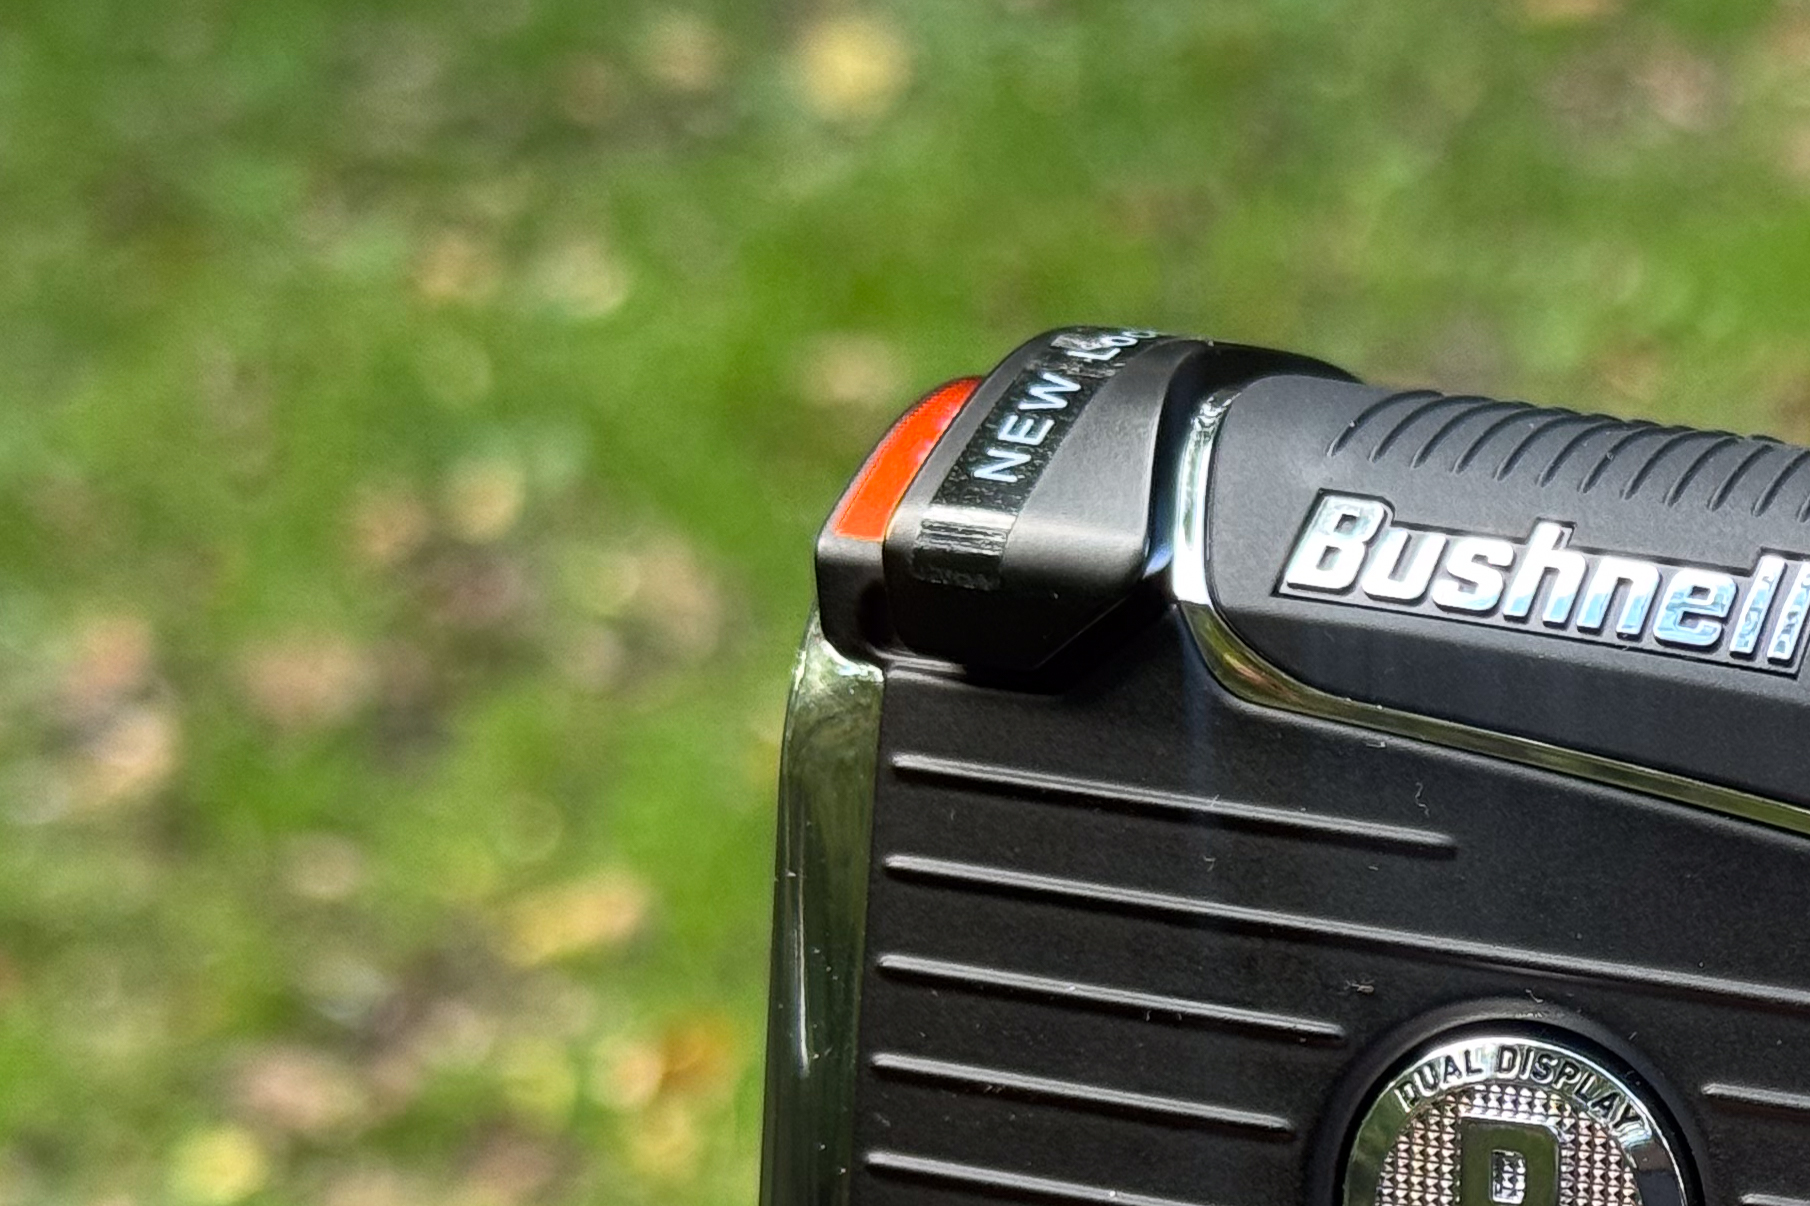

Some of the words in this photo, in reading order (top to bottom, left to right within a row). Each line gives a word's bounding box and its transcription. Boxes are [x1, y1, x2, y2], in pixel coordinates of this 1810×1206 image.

[972, 370, 1083, 483] NEW
[1394, 1048, 1485, 1114] DUAL
[1496, 1044, 1648, 1132] DISPLAY
